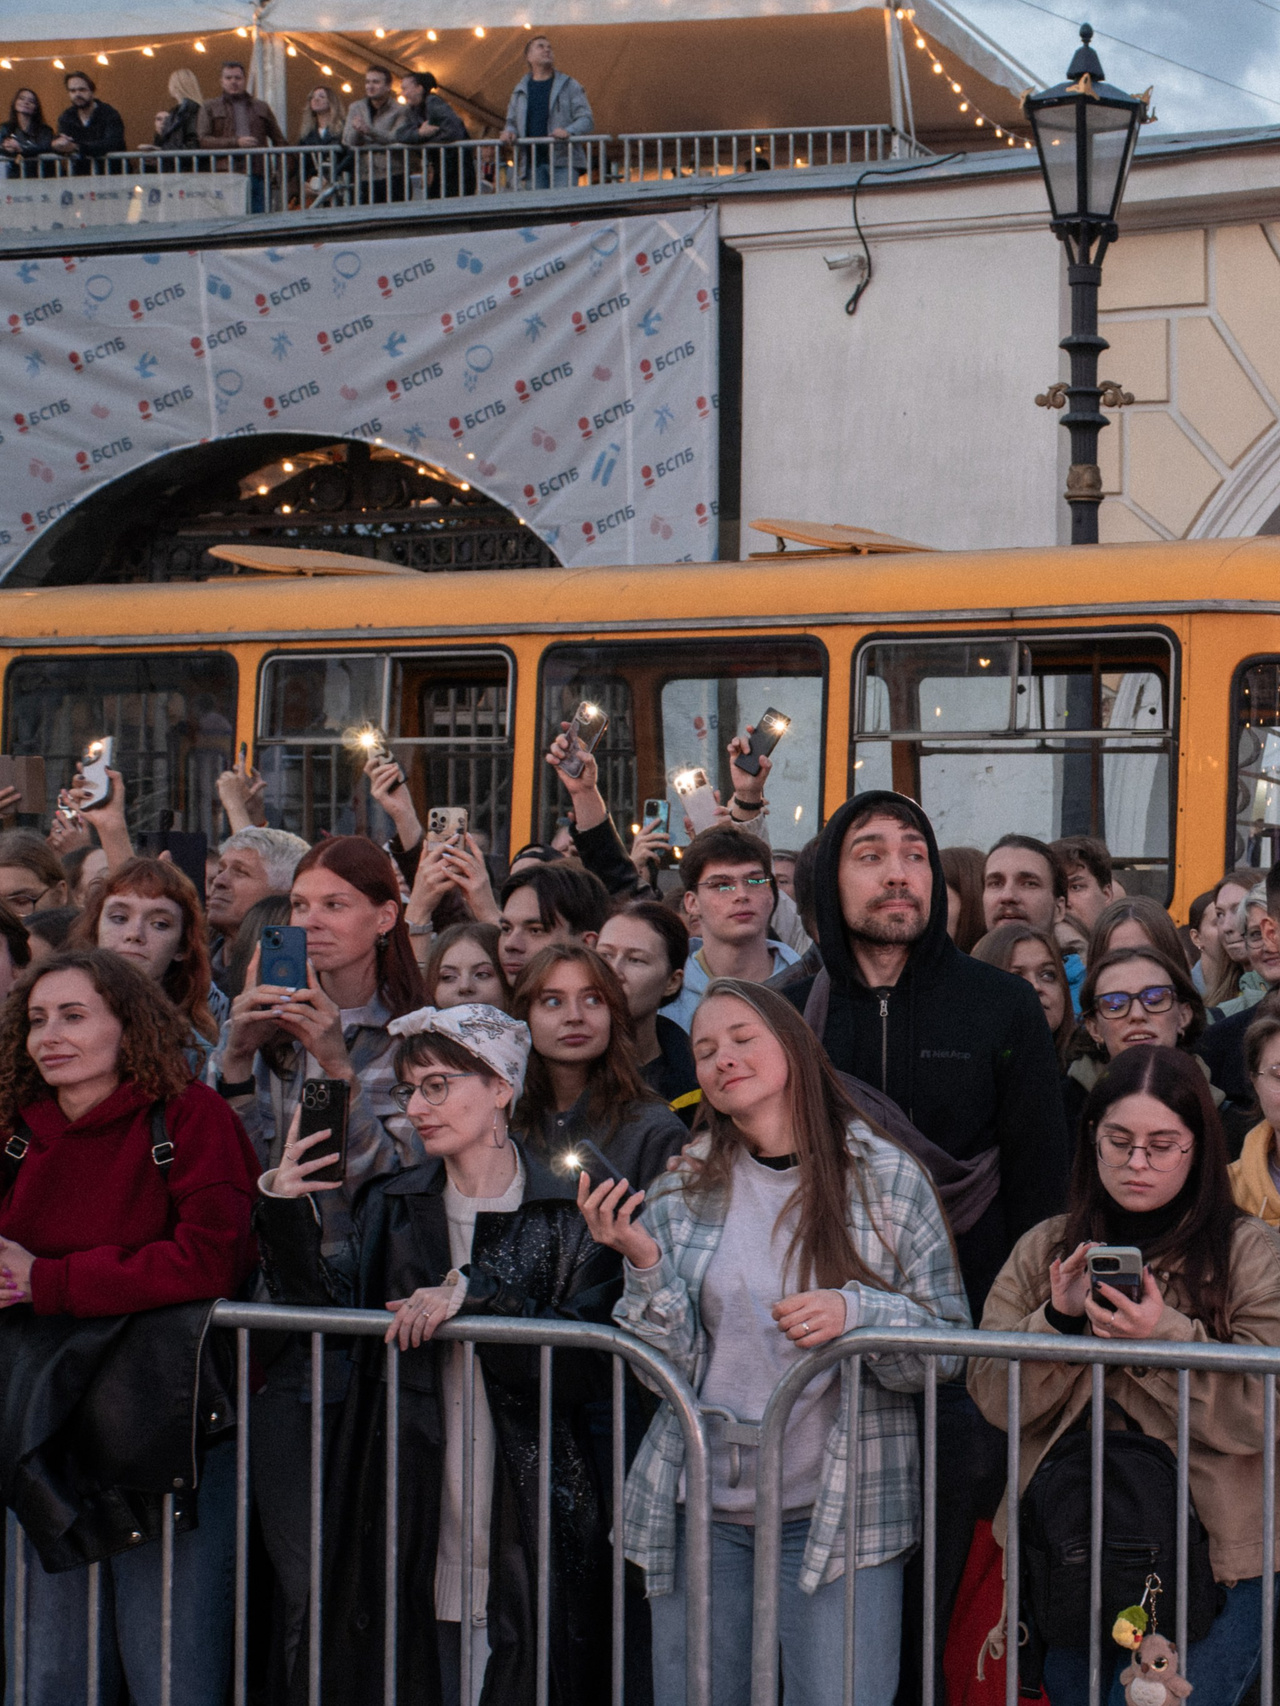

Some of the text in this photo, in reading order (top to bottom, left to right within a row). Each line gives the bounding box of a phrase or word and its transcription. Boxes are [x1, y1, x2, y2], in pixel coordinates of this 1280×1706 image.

[652, 234, 695, 264] БСПБ
[392, 259, 435, 288] БСПБ
[523, 256, 566, 286] БСПБ
[144, 282, 186, 312] БСПБ
[270, 278, 312, 306] БСПБ
[24, 298, 63, 327] БСПБ
[456, 295, 497, 325] БСПБ
[587, 293, 631, 324] БСПБ
[207, 320, 248, 350] БСПБ
[332, 315, 374, 344] БСПБ
[85, 336, 126, 363] БСПБ
[655, 341, 695, 372] БСПБ
[401, 362, 443, 391] БСПБ
[530, 362, 573, 392] БСПБ
[153, 386, 194, 412] БСПБ
[279, 381, 320, 409] БСПБ
[30, 398, 72, 426] БСПБ
[464, 400, 507, 429] БСПБ
[594, 399, 636, 429] БСПБ
[92, 436, 134, 464] БСПБ
[656, 447, 695, 477] БСПБ
[539, 467, 580, 498] БСПБ
[596, 505, 636, 535] БСПБ
